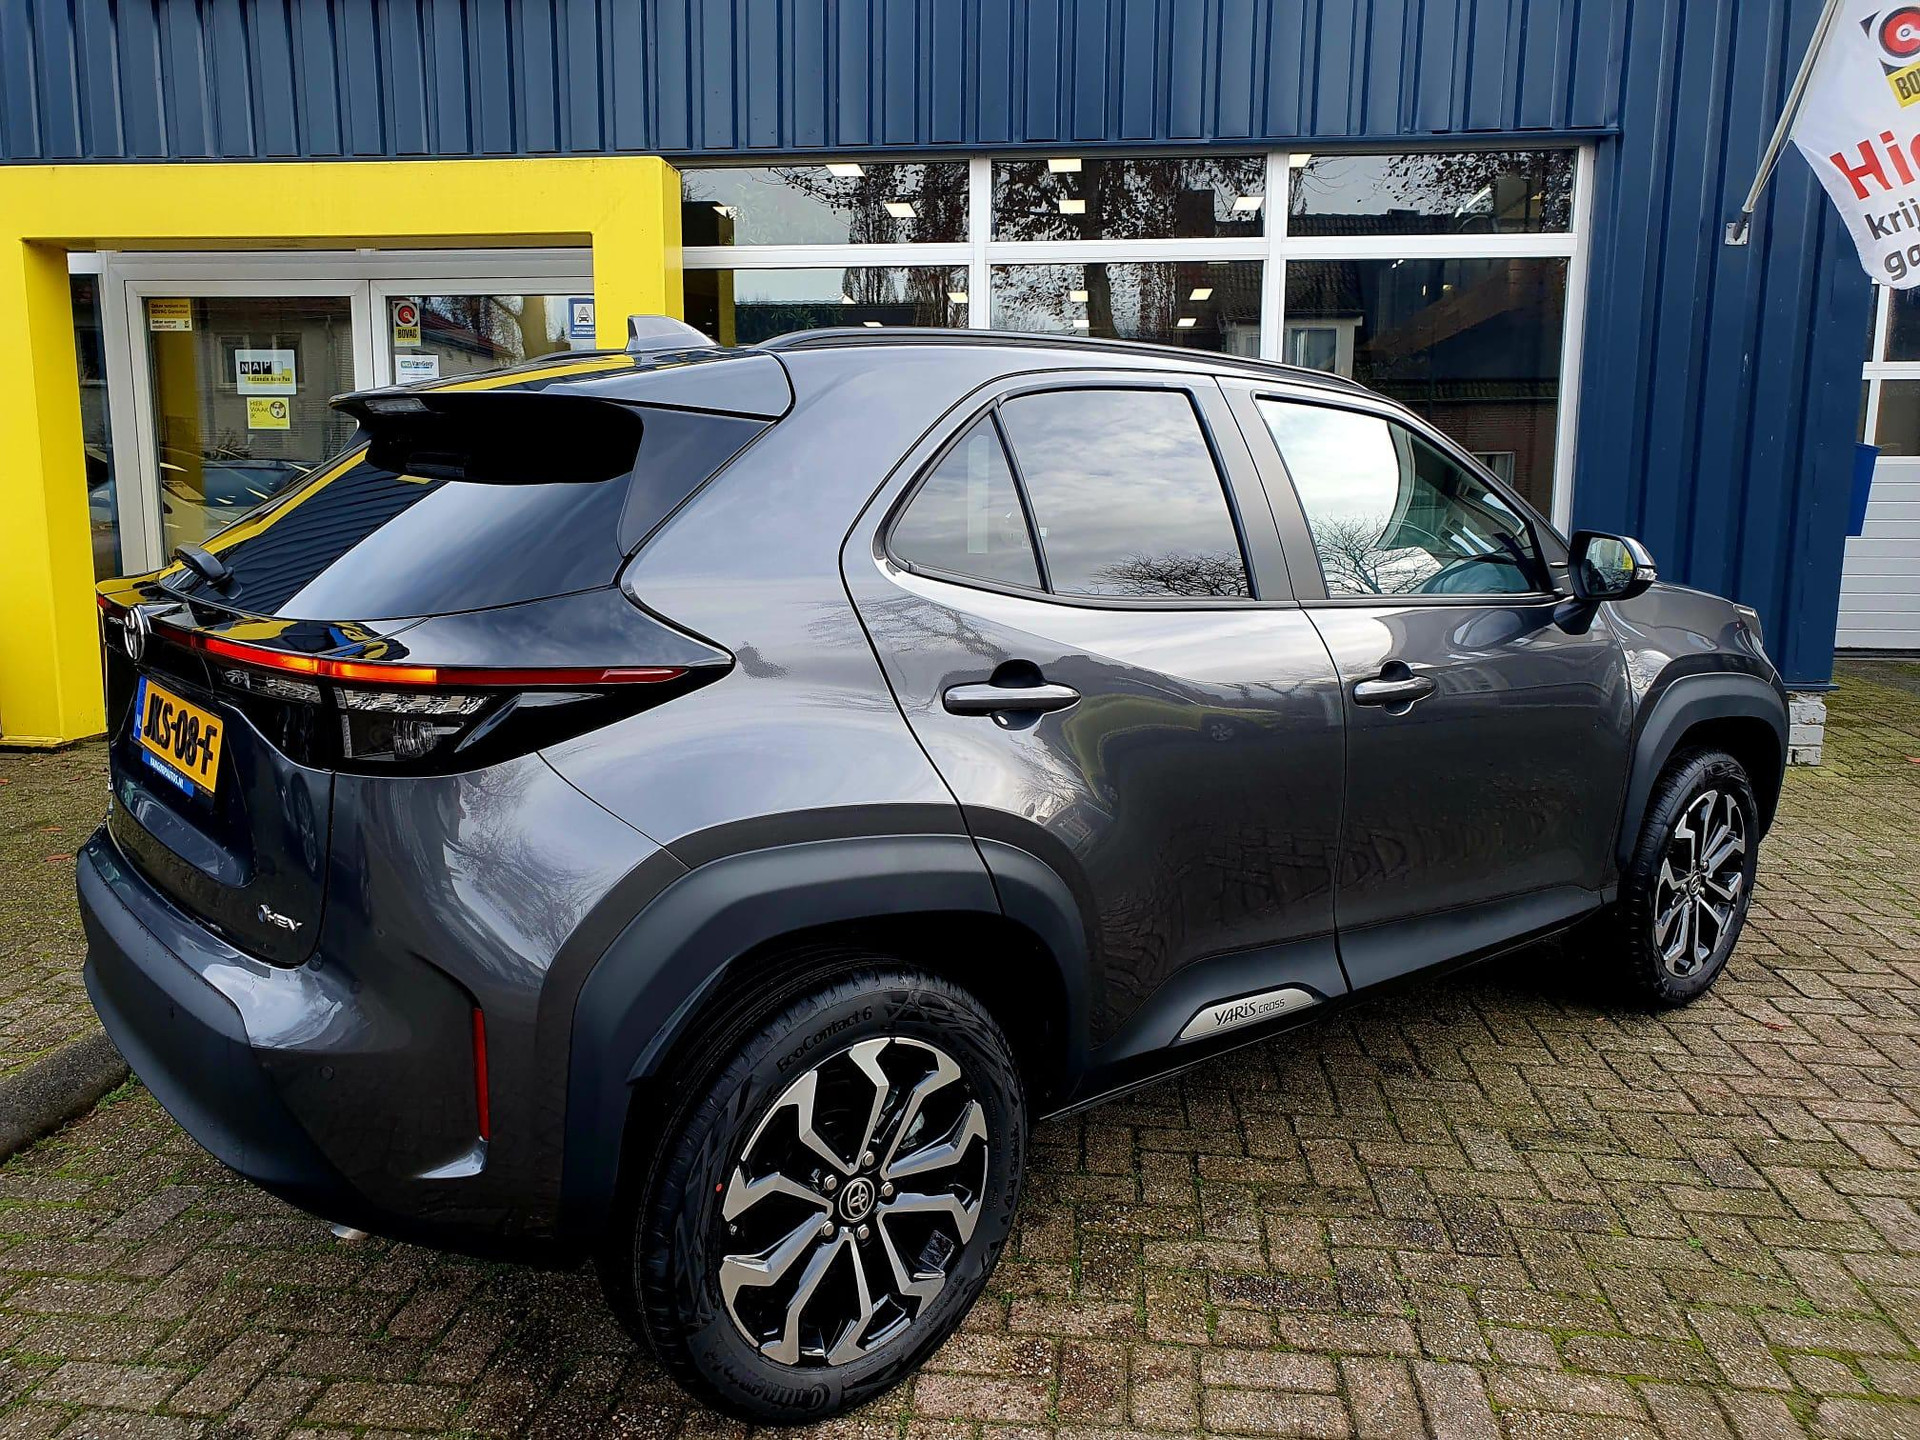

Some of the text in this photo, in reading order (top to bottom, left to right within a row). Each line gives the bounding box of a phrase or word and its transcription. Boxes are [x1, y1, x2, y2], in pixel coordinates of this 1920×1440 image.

[1895, 68, 1920, 100] BO
[397, 328, 417, 339] BOVAG
[240, 361, 272, 374] NAP
[412, 360, 434, 369] VanGorp
[144, 693, 217, 775] JKS-08-F
[1258, 998, 1285, 1014] CROSS
[775, 1010, 860, 1074] EcoContact
